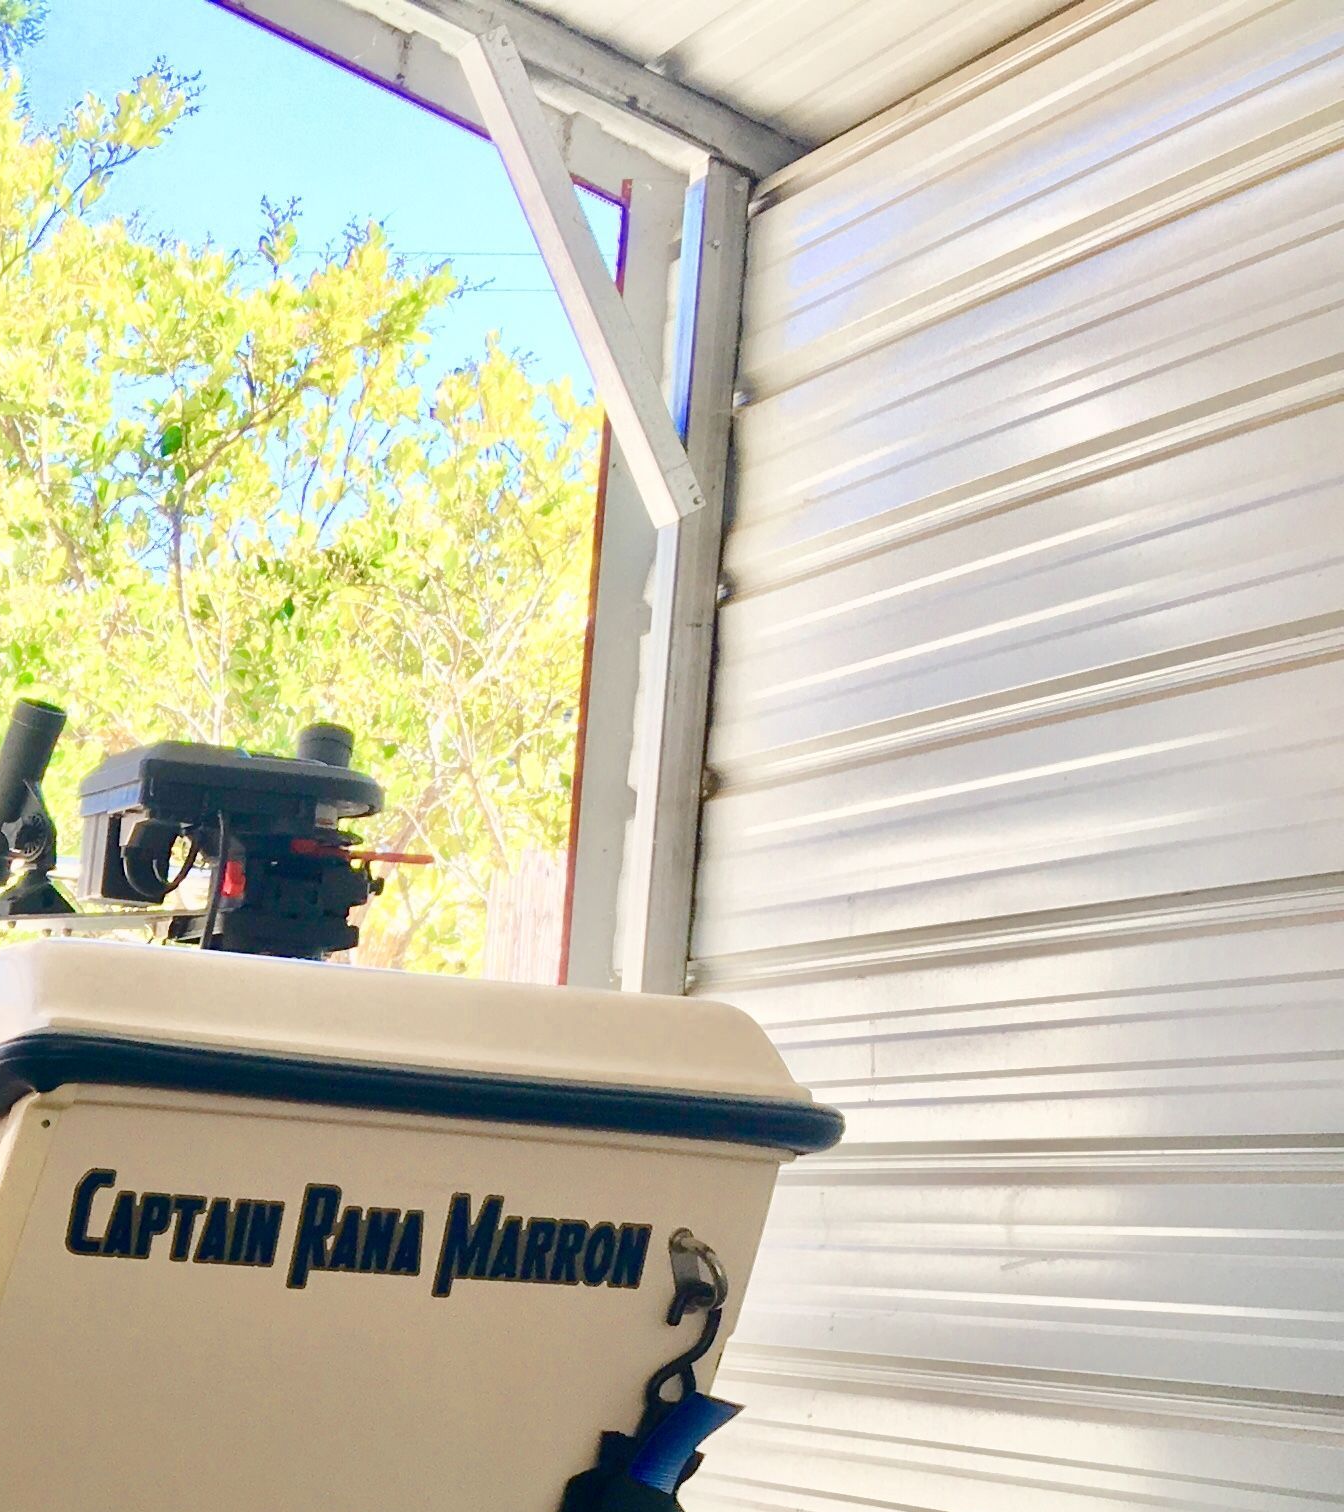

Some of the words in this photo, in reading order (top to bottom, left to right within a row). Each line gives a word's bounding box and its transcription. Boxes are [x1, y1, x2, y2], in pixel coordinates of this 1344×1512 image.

[65, 1167, 286, 1268] CAPTAIN
[285, 1182, 425, 1289] RANA
[431, 1191, 653, 1298] MARRON
